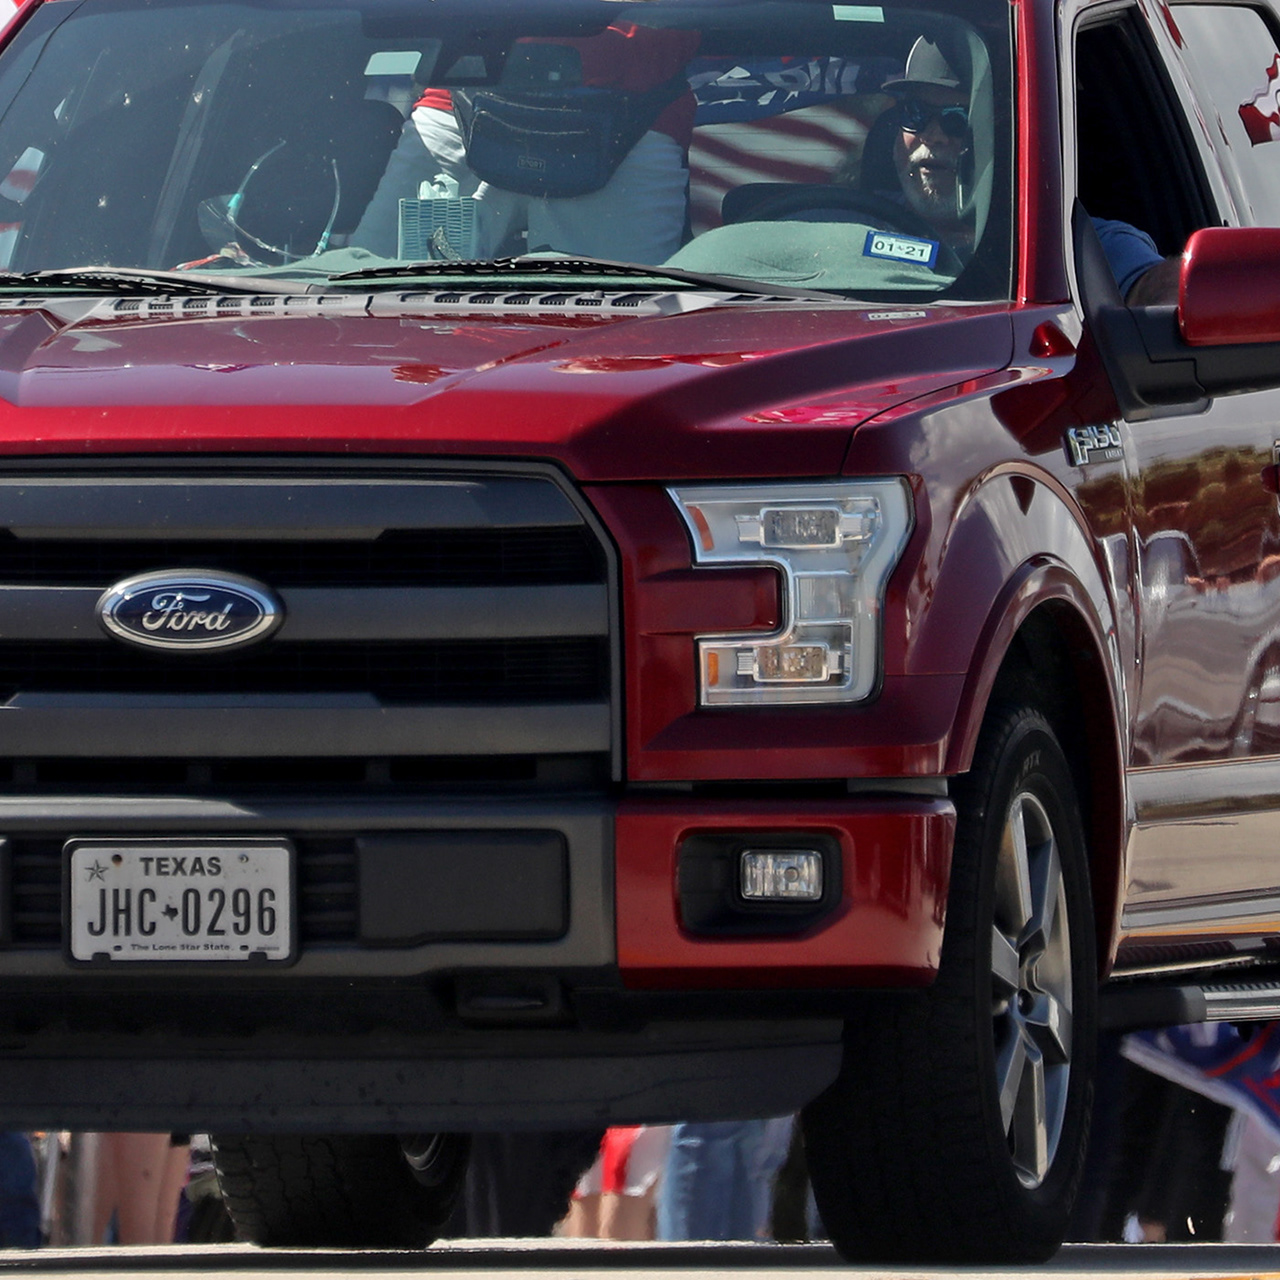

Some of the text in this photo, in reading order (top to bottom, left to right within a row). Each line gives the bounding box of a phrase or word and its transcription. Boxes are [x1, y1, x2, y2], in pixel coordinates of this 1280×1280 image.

[142, 592, 234, 631] Ford
[139, 856, 222, 877] TEXAS
[87, 888, 277, 937] JHC 0296
[130, 943, 231, 952] The Lone Star State
